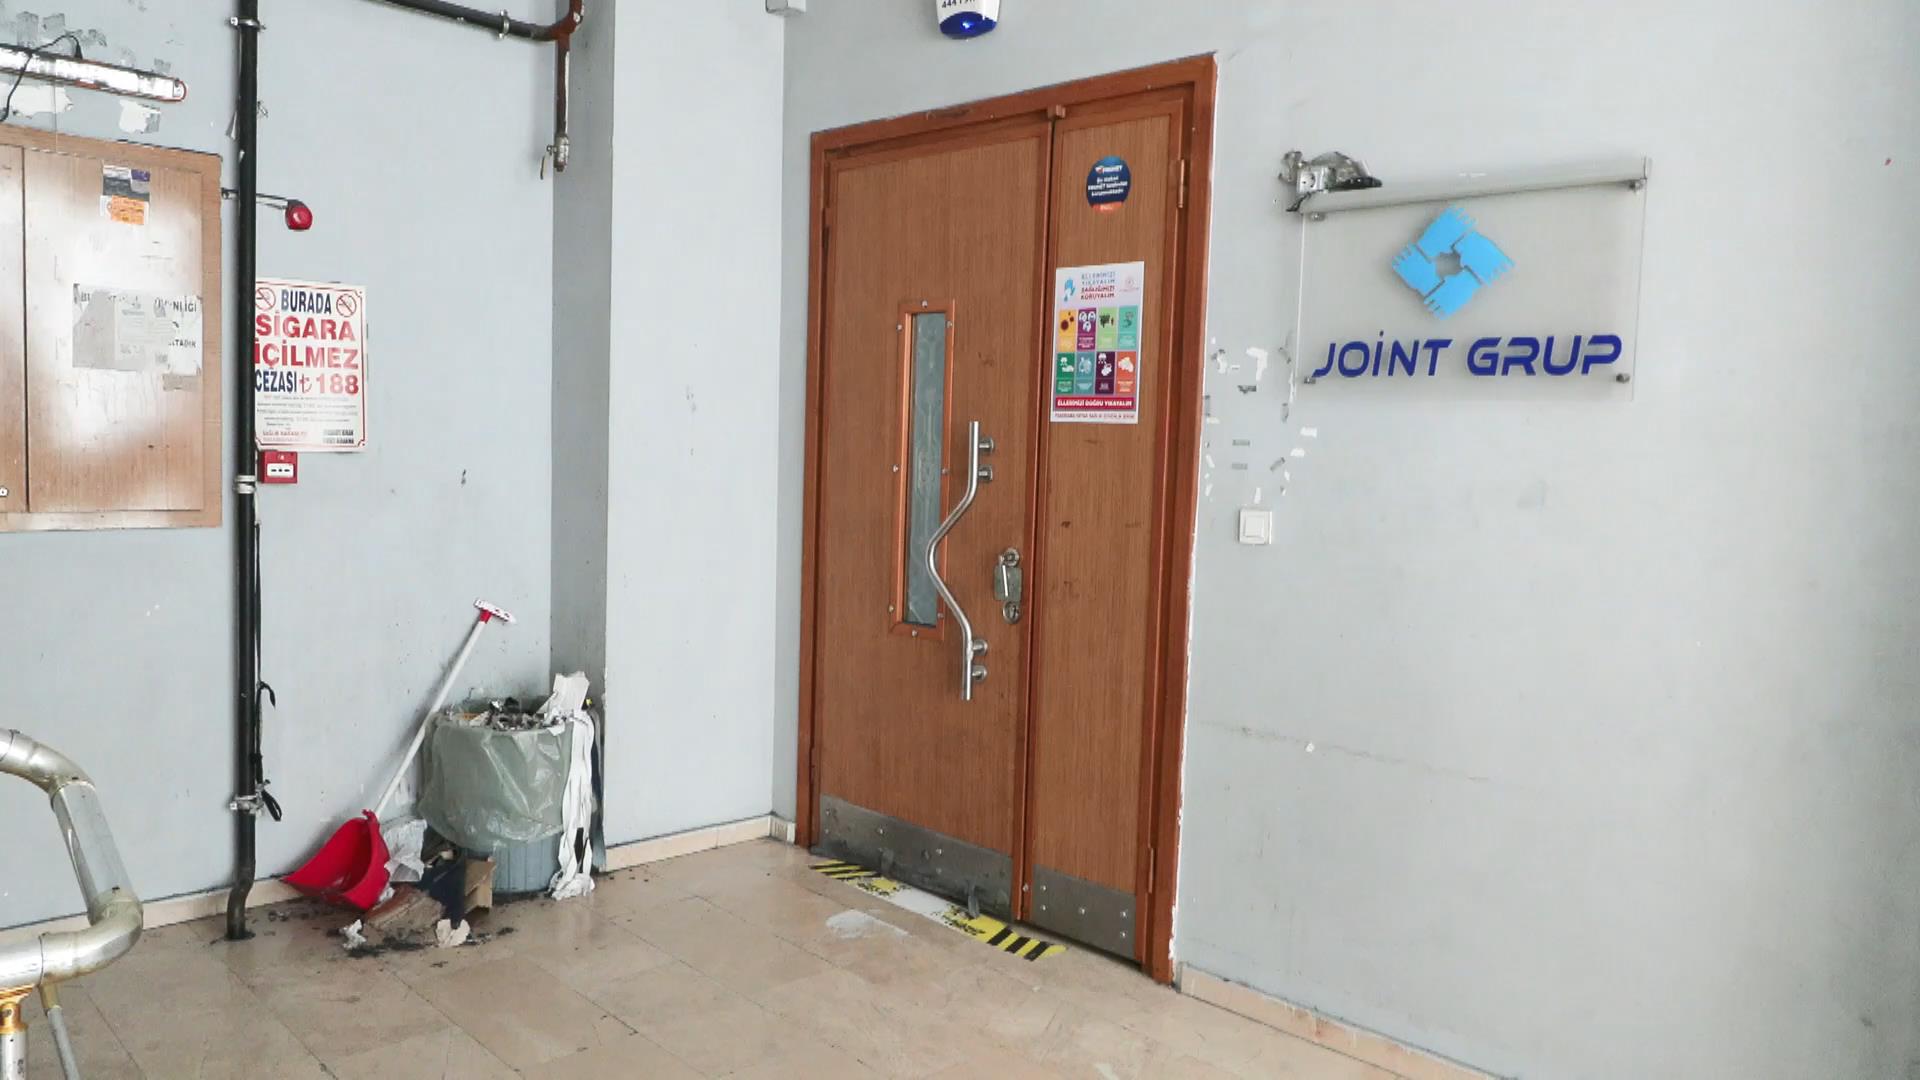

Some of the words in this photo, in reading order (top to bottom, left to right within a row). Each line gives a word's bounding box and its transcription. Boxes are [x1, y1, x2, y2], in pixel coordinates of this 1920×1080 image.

[281, 289, 332, 314] BURADA
[256, 311, 356, 341] SİGARA
[254, 337, 359, 369] İÇİLMEZ
[1467, 335, 1623, 377] GRUP
[255, 369, 297, 393] CEZASI
